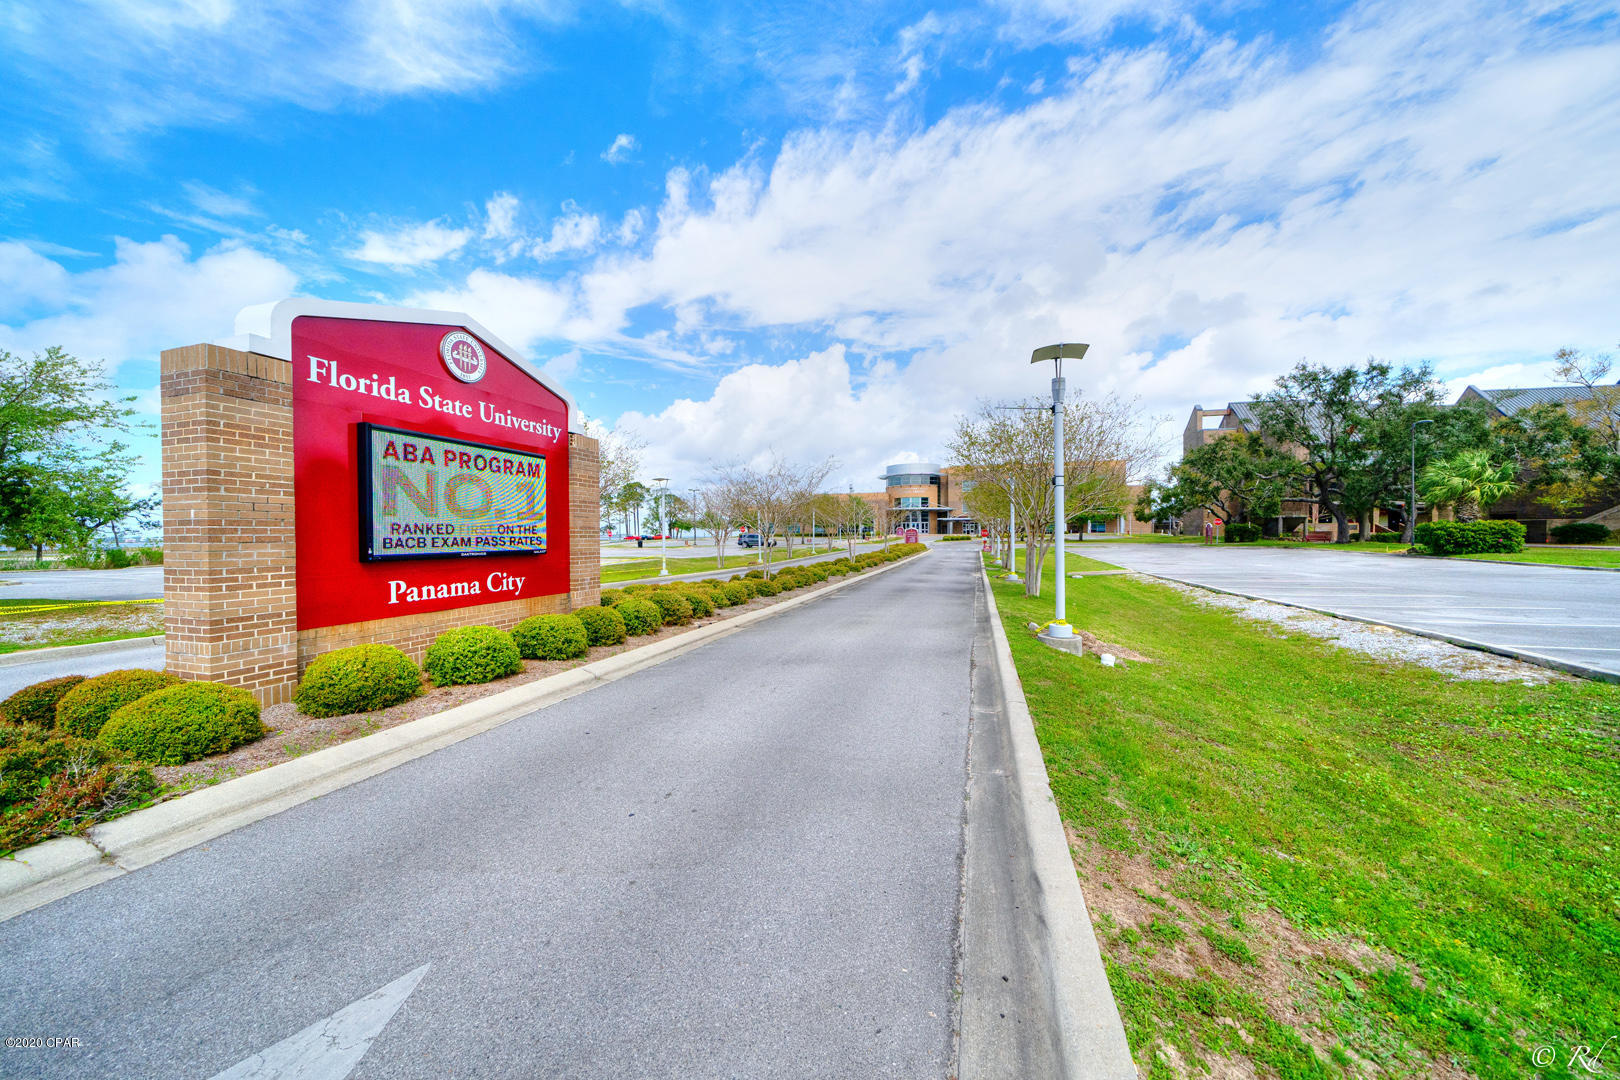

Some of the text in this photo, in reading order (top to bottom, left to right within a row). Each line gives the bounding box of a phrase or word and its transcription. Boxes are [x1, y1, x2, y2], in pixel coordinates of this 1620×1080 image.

[306, 355, 562, 443] Florida State University
[383, 440, 541, 478] ABA PROGRAM
[383, 536, 543, 549] BACB EXAM PASS RATES
[391, 522, 455, 535] RANKED
[497, 524, 514, 534] ON
[518, 524, 538, 534] THE
[388, 572, 526, 604] Panama City
